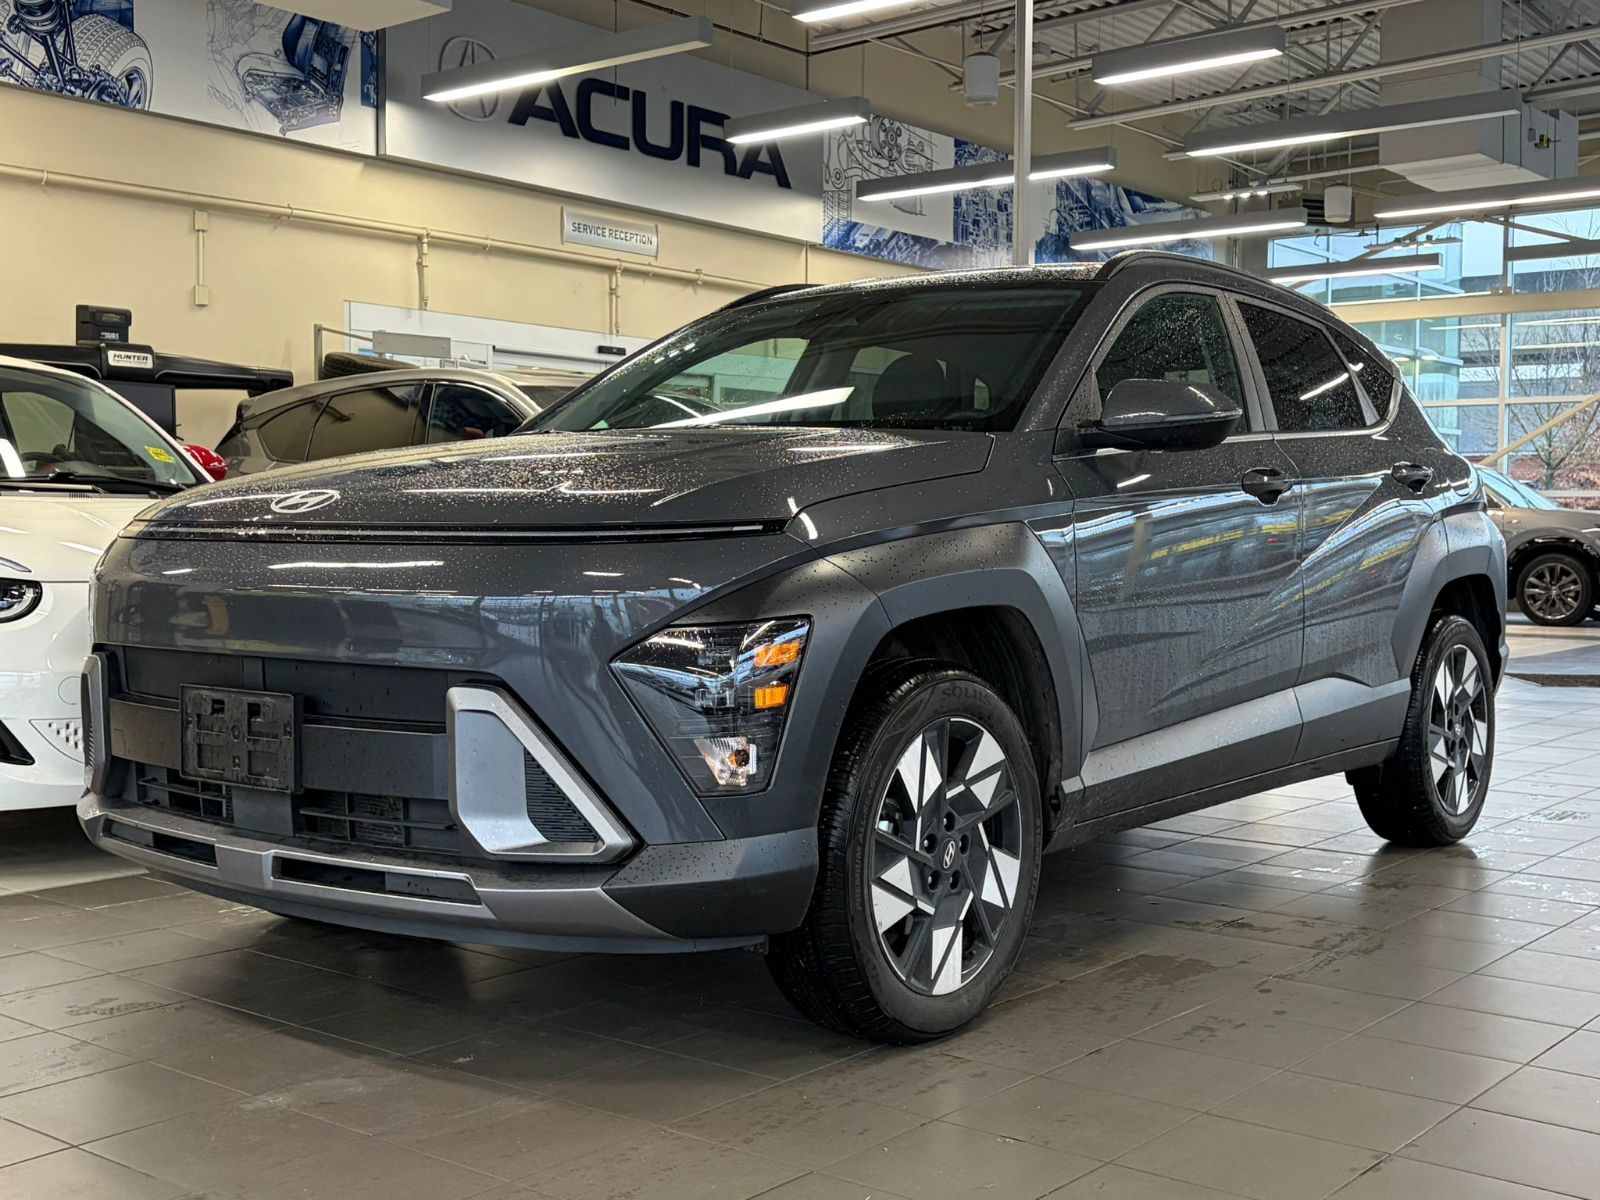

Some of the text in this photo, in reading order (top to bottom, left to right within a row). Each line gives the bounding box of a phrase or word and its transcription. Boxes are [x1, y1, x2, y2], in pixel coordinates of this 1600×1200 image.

[508, 77, 792, 189] ACURA
[572, 222, 653, 246] SERVICE RECEPTION
[112, 353, 149, 361] HUNTER
